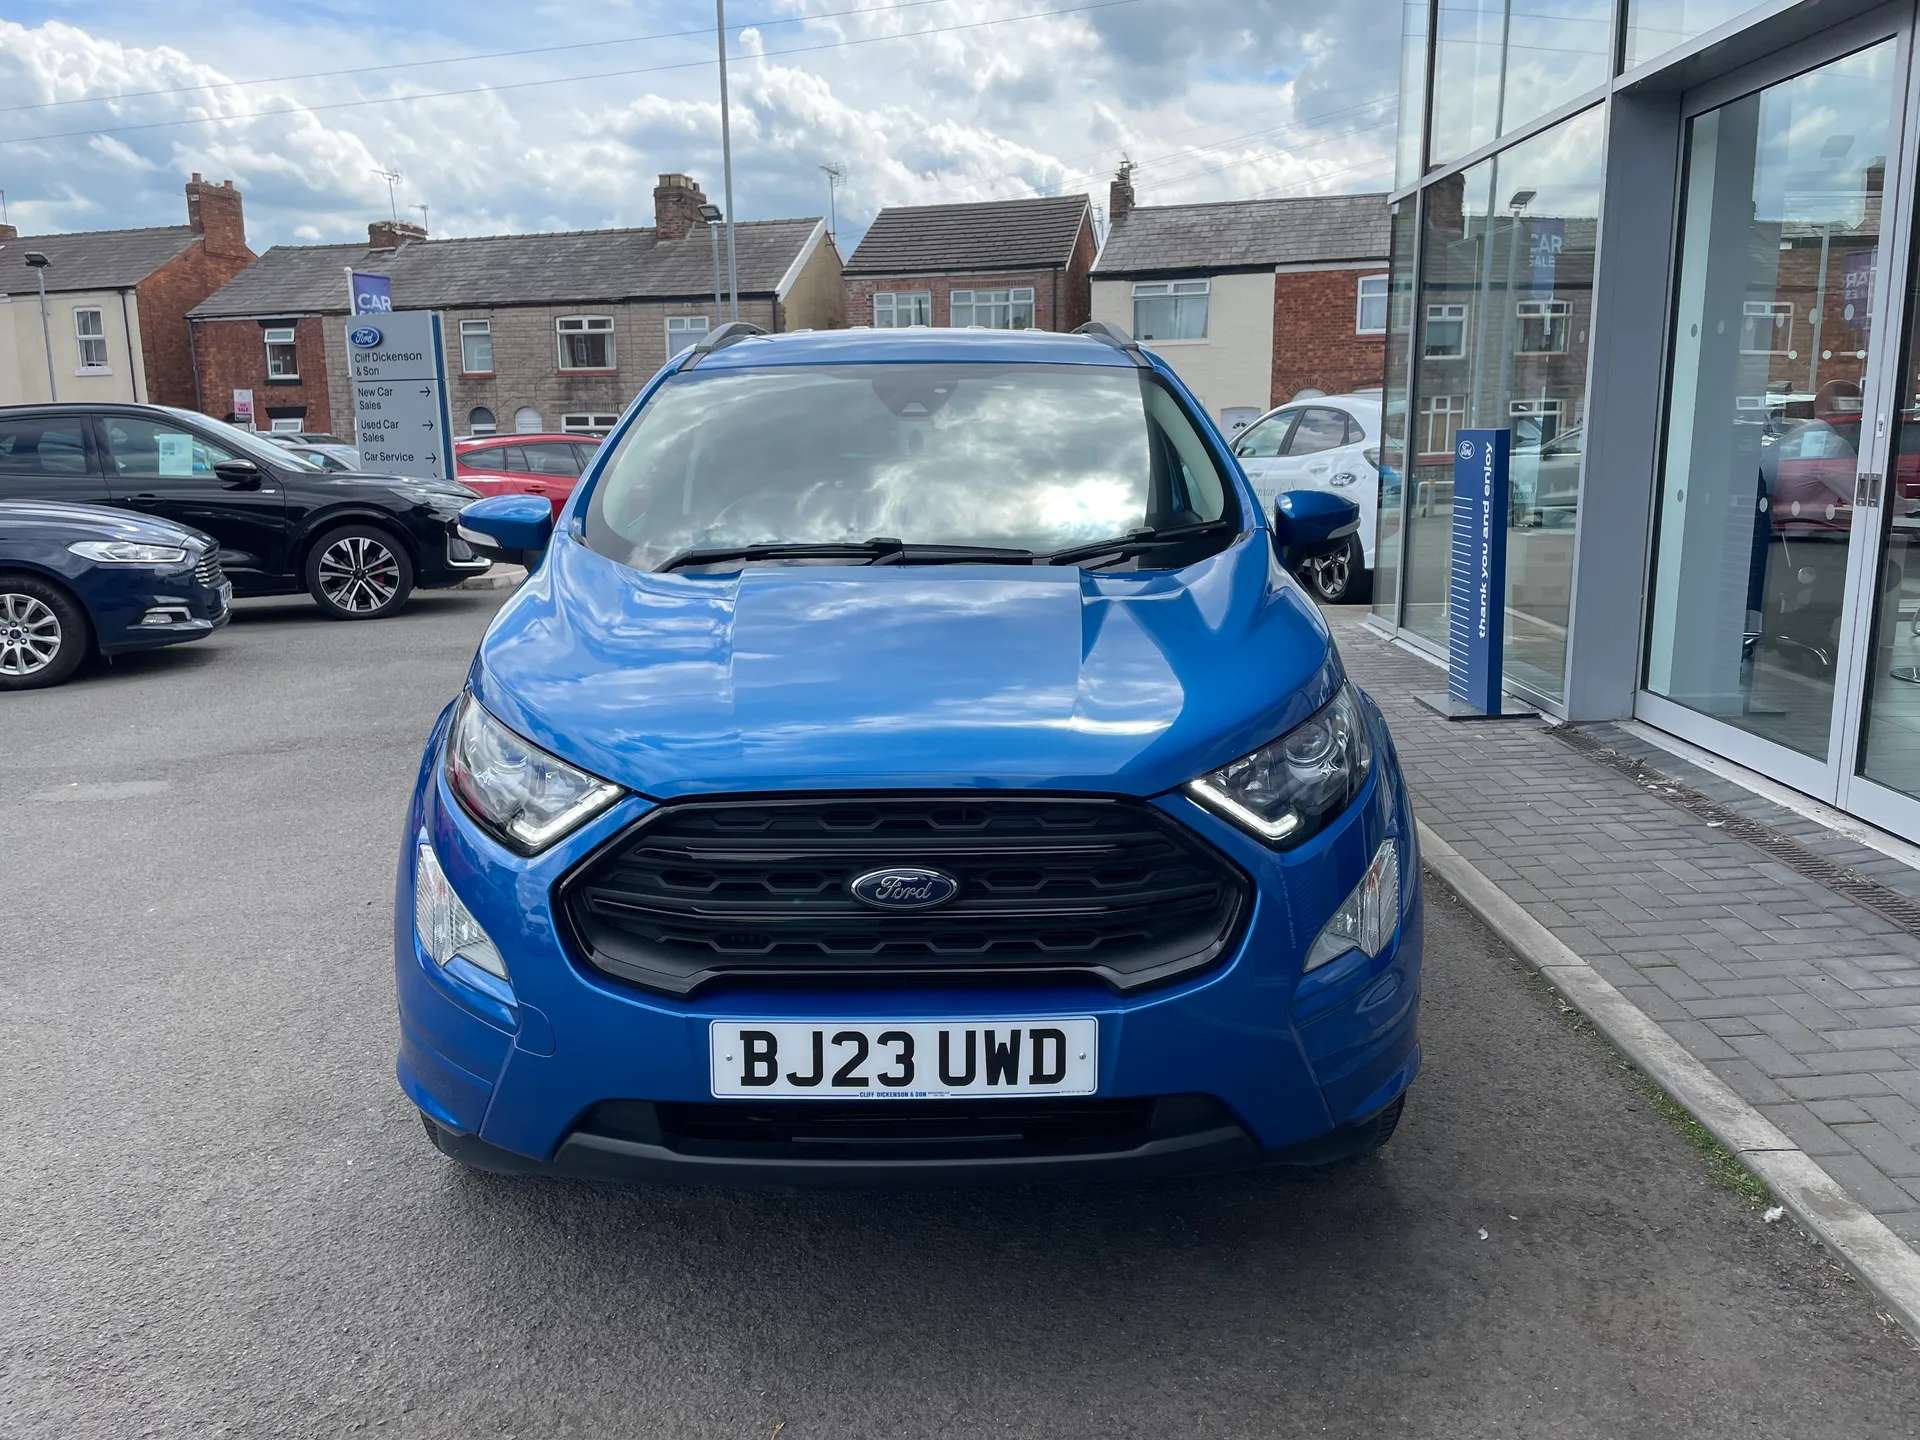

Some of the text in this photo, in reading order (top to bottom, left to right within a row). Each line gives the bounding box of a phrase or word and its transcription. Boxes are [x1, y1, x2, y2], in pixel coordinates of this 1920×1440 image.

[1530, 232, 1563, 254] CAR
[357, 293, 392, 312] CAR
[354, 352, 423, 363] Cliff Dickenson
[356, 366, 380, 376] & Son
[358, 387, 393, 397] New Car
[359, 400, 382, 410] Sales
[361, 419, 399, 430] Used Car
[362, 432, 385, 442] Sales
[364, 451, 415, 461] Car Service
[1478, 441, 1493, 639] thank you and enjoy
[875, 876, 933, 899] Ford
[739, 1028, 1067, 1087] BJ23 UWD
